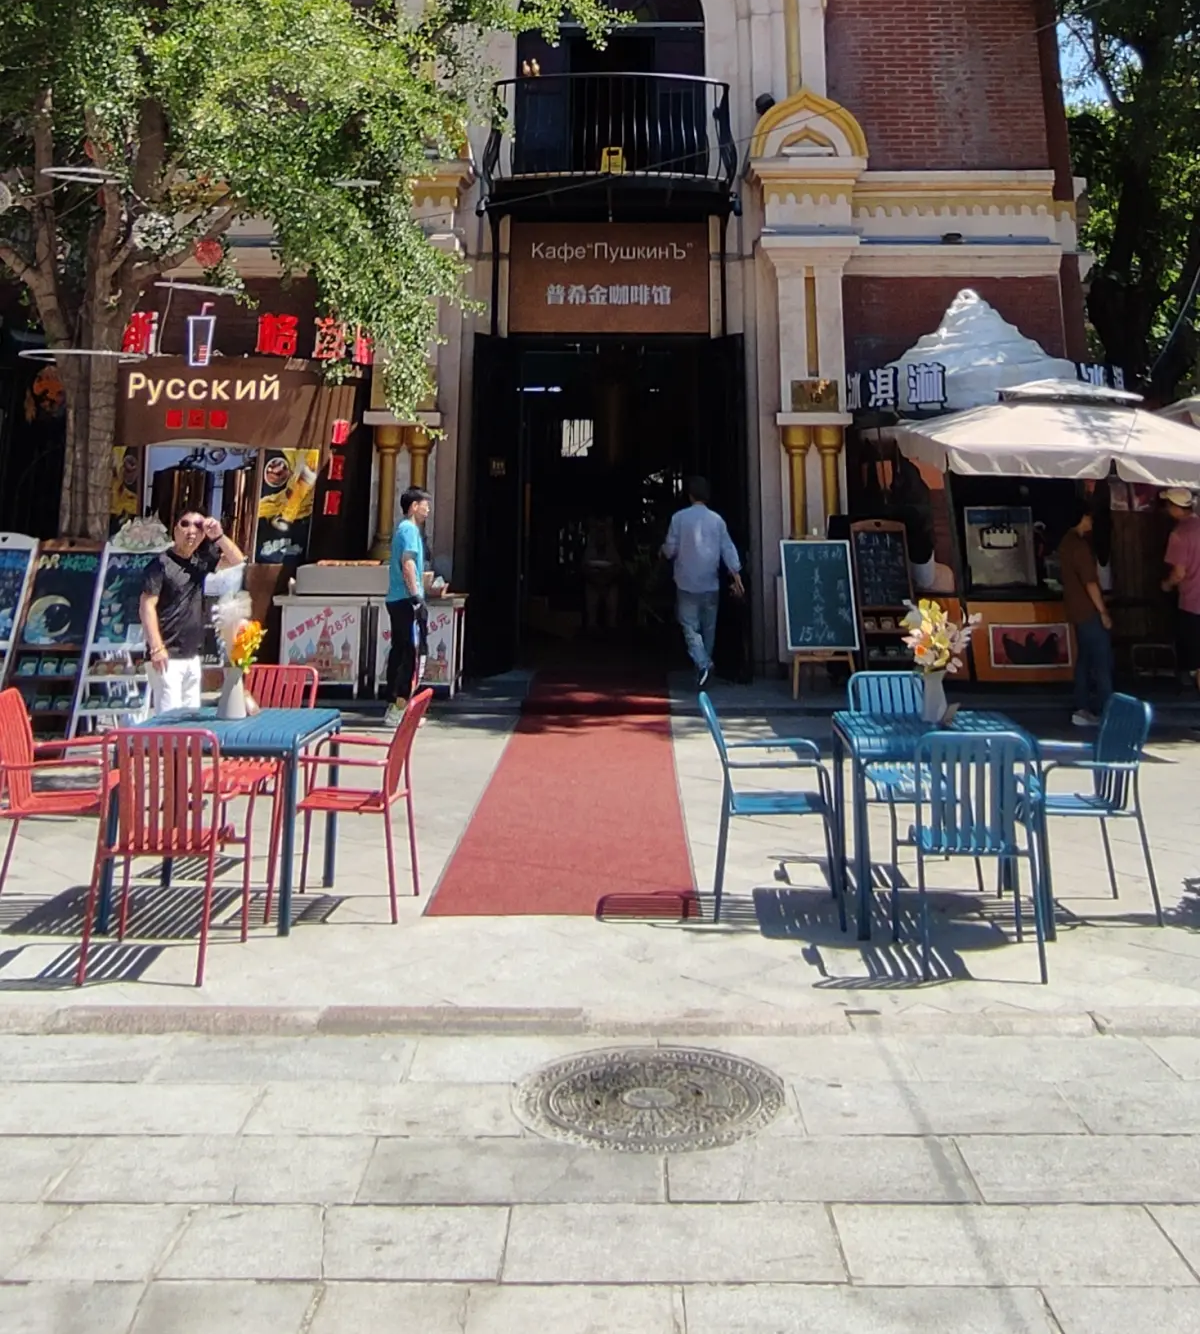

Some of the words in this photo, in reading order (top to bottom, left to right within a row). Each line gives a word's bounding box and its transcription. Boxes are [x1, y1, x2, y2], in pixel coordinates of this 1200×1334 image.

[546, 283, 672, 306] 普希金咖啡馆
[127, 372, 280, 405] Русский
[846, 362, 945, 410] 冰淇淋
[328, 612, 356, 636] 28元
